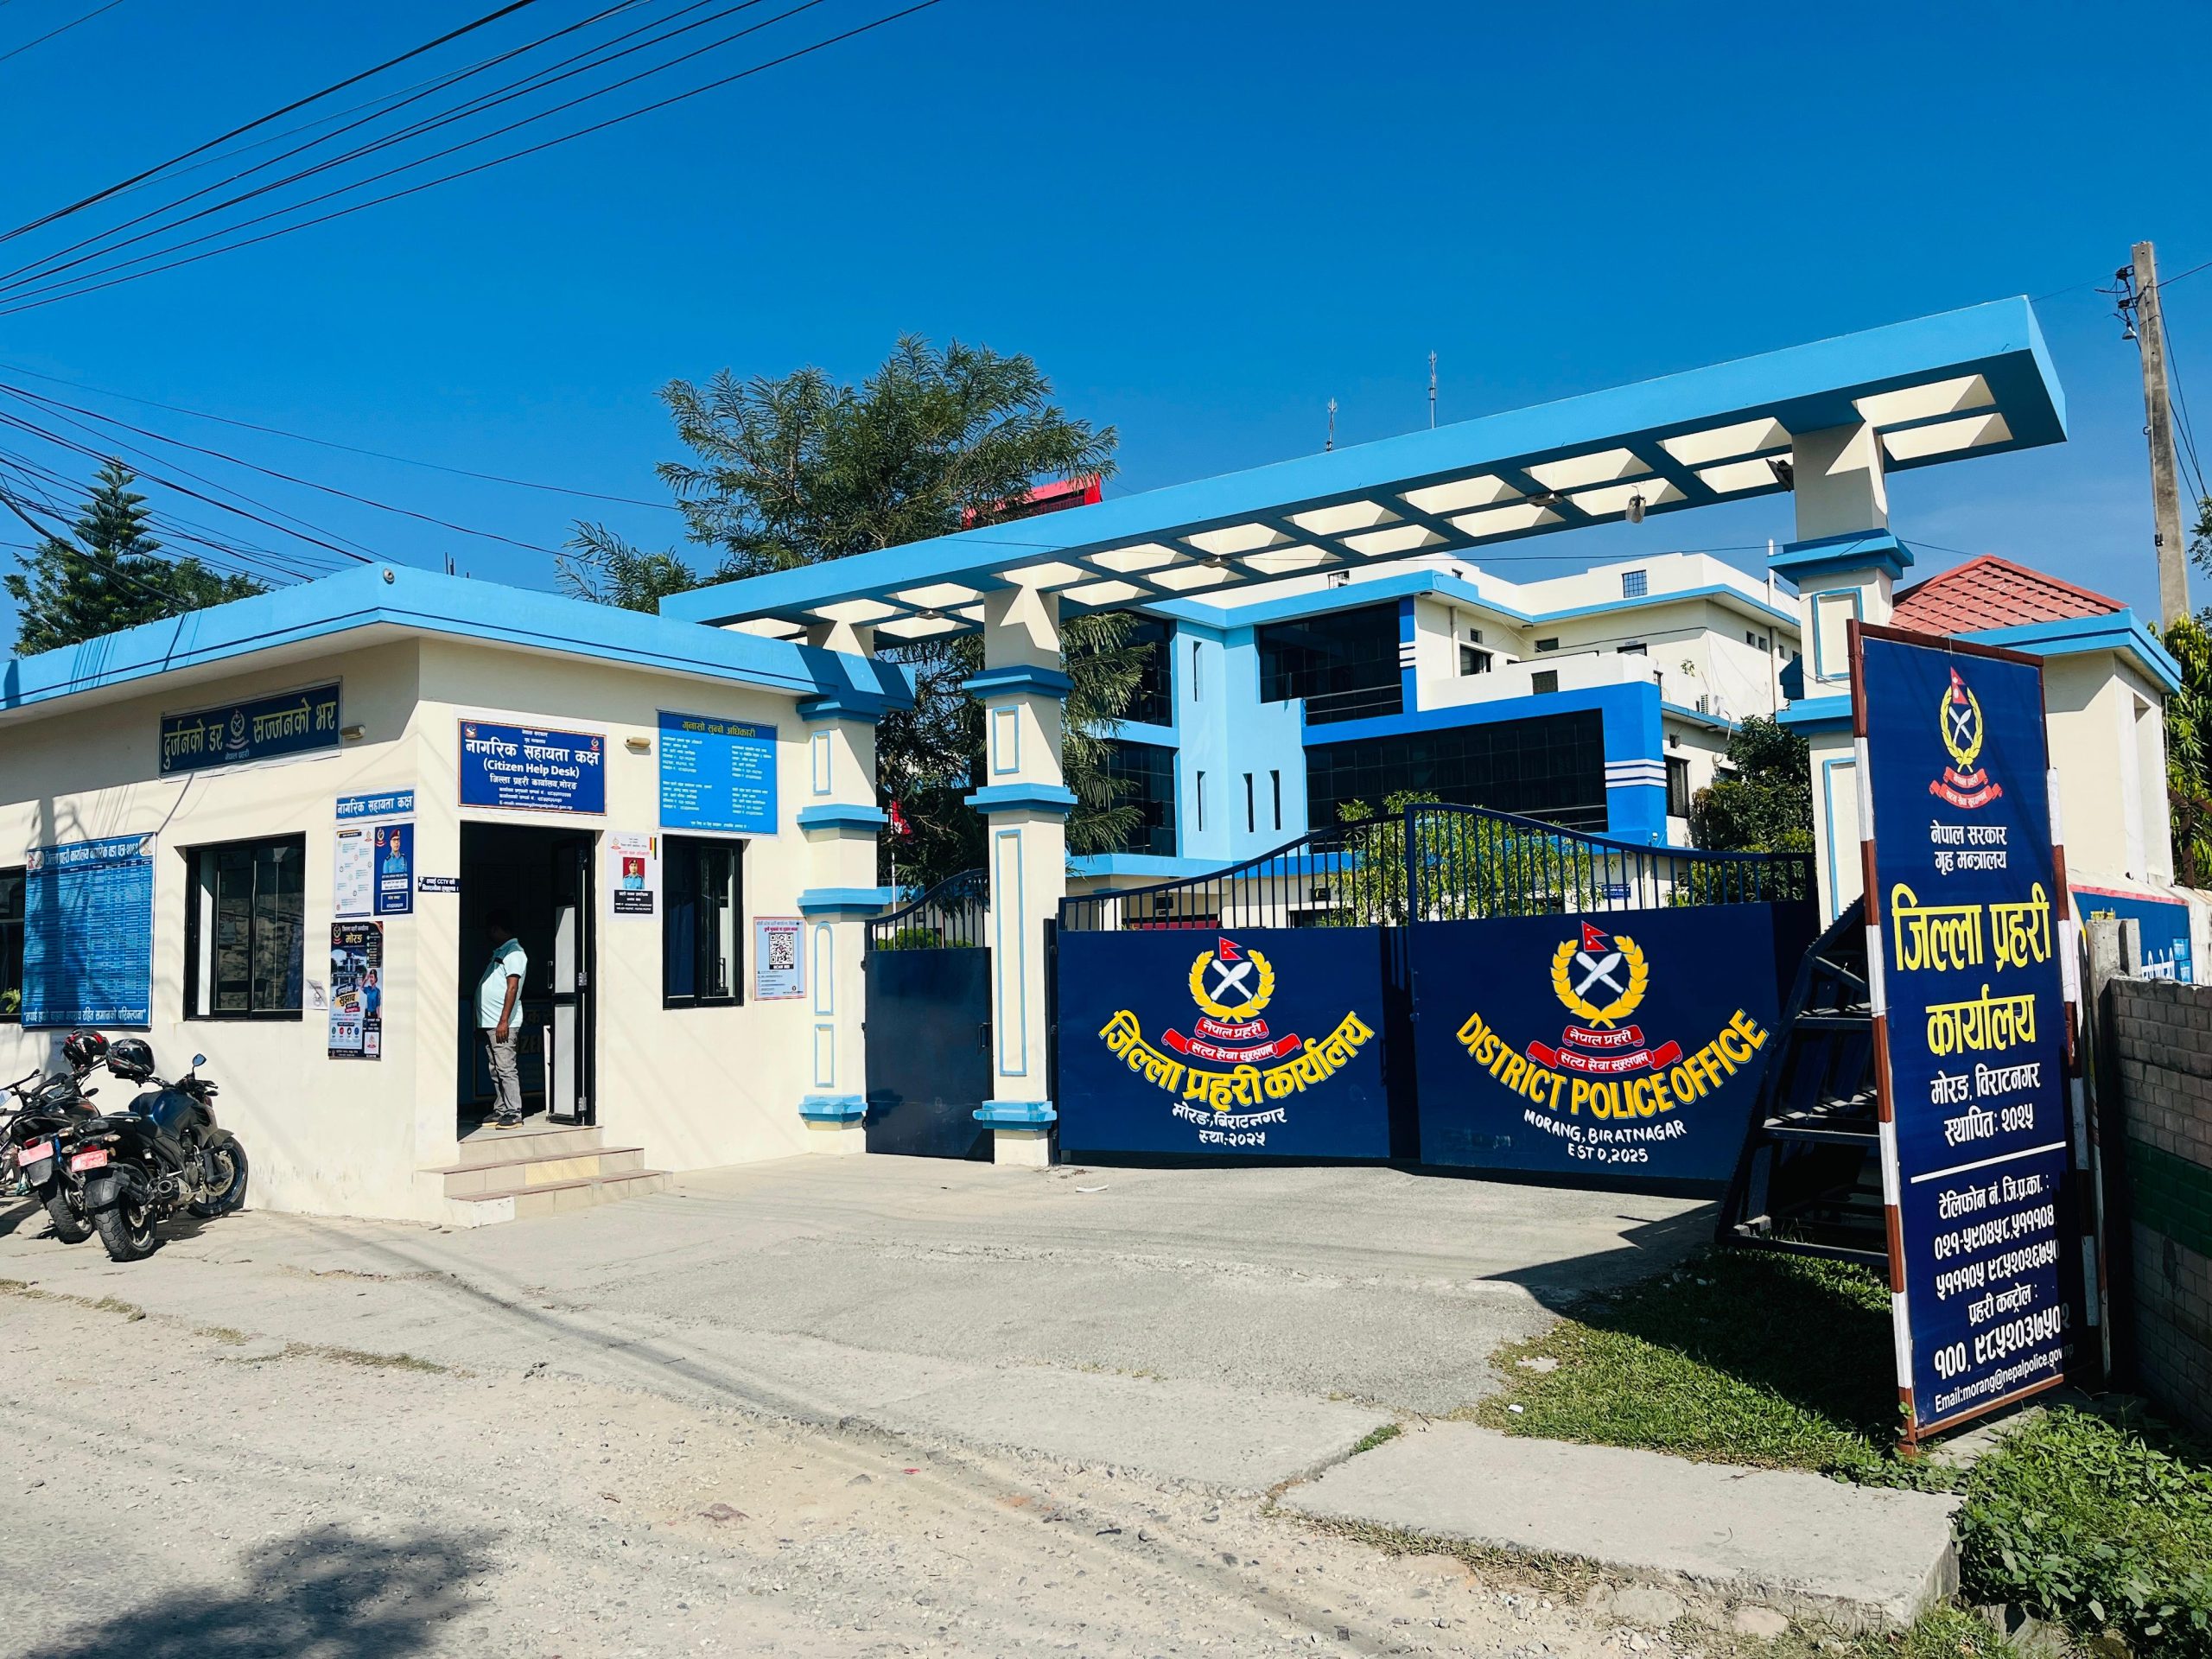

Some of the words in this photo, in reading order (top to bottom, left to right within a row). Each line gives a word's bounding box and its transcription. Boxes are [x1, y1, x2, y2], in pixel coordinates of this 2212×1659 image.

[163, 719, 206, 769] दुर्जनको
[209, 723, 224, 752] डर
[252, 697, 312, 744] सज्जनको
[315, 701, 336, 730] भर
[465, 736, 518, 758] नागरिक
[524, 745, 570, 762] सहायता
[574, 750, 600, 766] कक्ष
[484, 757, 524, 772] (Citizen
[525, 763, 550, 777] Help
[551, 766, 580, 779] Desk)
[489, 772, 511, 785] जिल्ला
[512, 774, 529, 787] प्रहरी
[337, 798, 365, 816] नागरिक
[367, 798, 395, 813] सहायता
[397, 795, 413, 810] कक्ष
[1929, 819, 1965, 845] नेपाल
[1967, 826, 2007, 846] सरकार
[1934, 851, 1955, 875] गृह
[1956, 851, 2007, 870] मन्त्रालय
[345, 932, 363, 944] मोरङ
[1891, 883, 1984, 972] जिल्ला
[1988, 882, 2051, 973] प्रहरी
[1234, 1021, 1262, 1038] प्रहरी
[1925, 983, 2037, 1056] कार्यालय
[1192, 1041, 1216, 1058] सत्य
[1569, 1028, 1602, 1046] नेपाल
[1603, 1029, 1632, 1046] प्रहरी
[1098, 1009, 1185, 1093] जिल्ला
[1182, 1064, 1264, 1112] प्रहरी
[1262, 1010, 1376, 1098] कार्यालय
[1456, 1012, 1567, 1111] DISTRICT
[1570, 1071, 1676, 1121] POLICE
[1670, 1007, 1770, 1104] OFFICE
[1560, 1051, 1586, 1068] सत्य
[1587, 1058, 1610, 1071] सेवा
[1974, 1062, 2041, 1097] विराटनगर
[1587, 1119, 1688, 1145] BIRATNAGAR
[2000, 1103, 2034, 1133] २०२५
[1938, 1185, 1986, 1220] टेलिफोन
[1936, 1262, 1985, 1300] ५१११०५
[1967, 1292, 1994, 1327] प्रहरी
[1996, 1281, 2032, 1313] कन्ट्रोल
